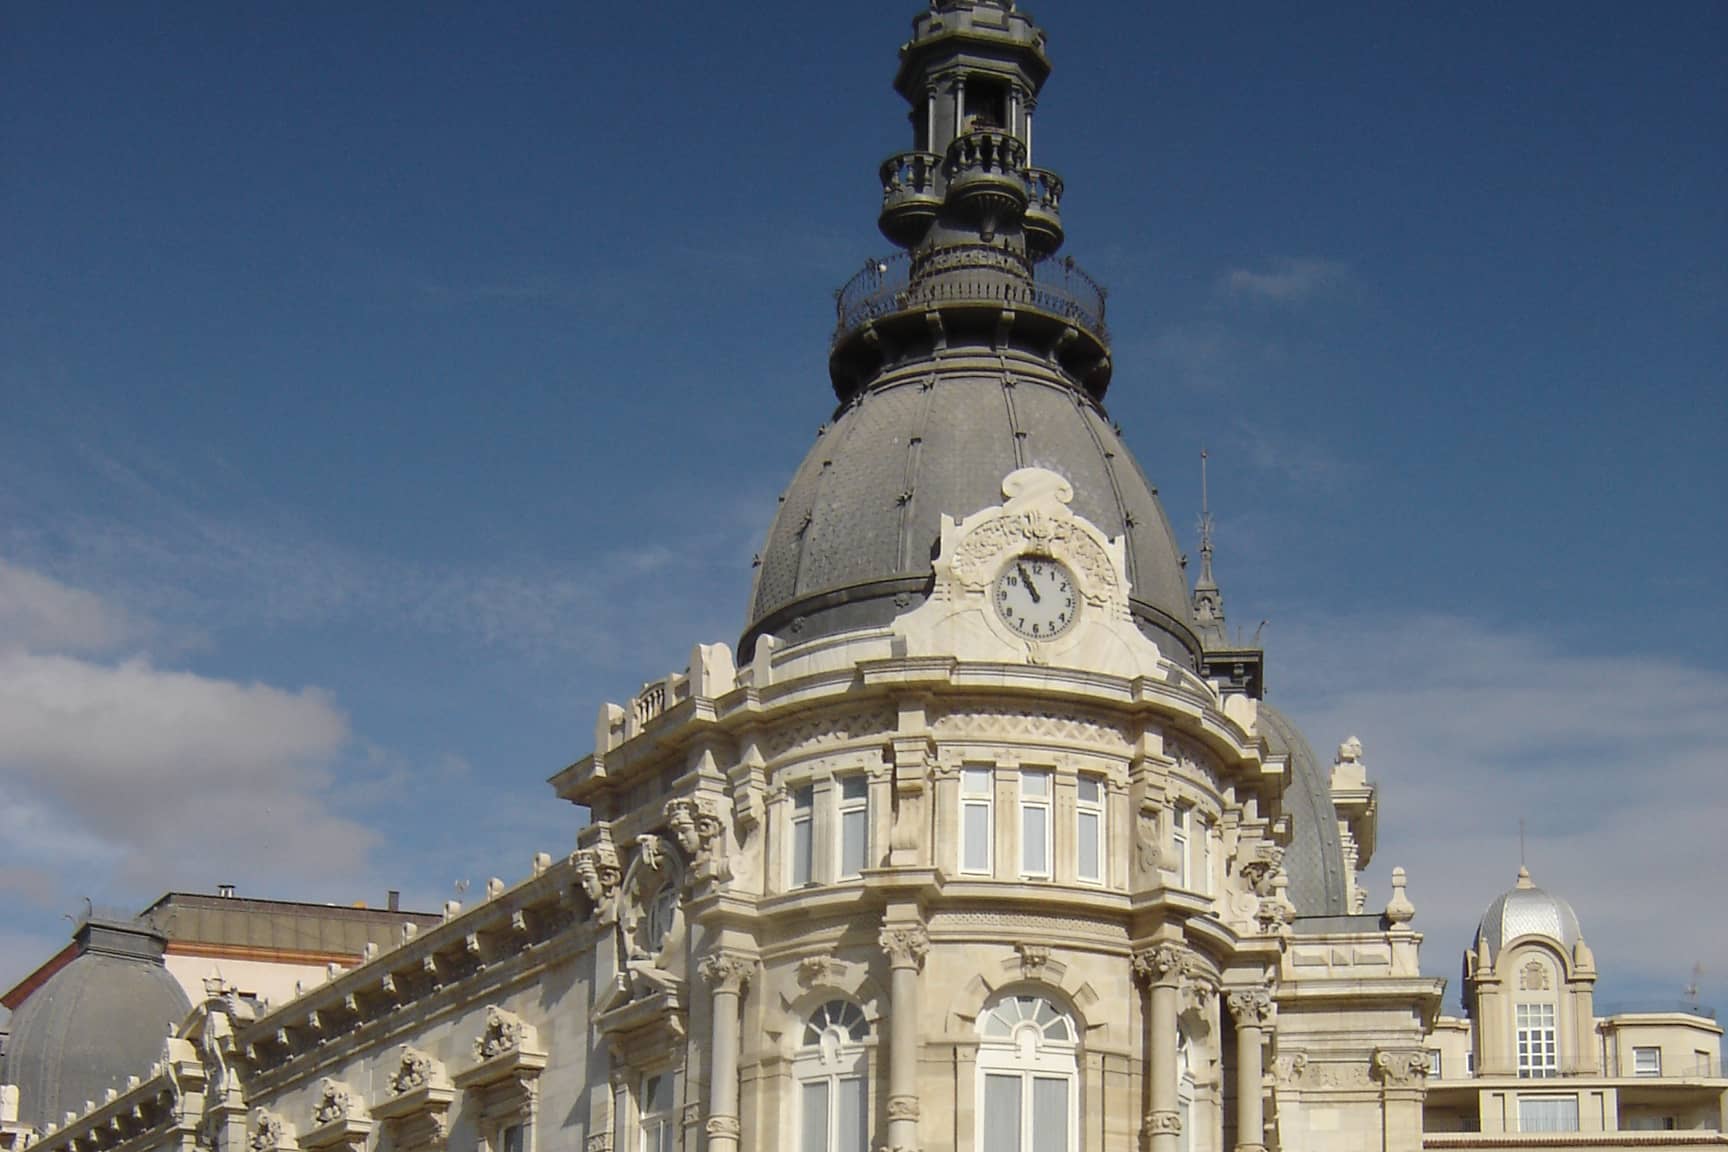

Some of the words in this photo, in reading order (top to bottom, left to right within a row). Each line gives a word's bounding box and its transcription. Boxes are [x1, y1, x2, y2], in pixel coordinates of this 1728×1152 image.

[1032, 565, 1042, 575] 12
[1007, 576, 1017, 586] 10
[1050, 571, 1055, 581] 1
[1060, 582, 1067, 592] 2
[1001, 590, 1008, 601] 9
[1065, 598, 1072, 608] 3
[1018, 617, 1025, 628] 7
[1058, 612, 1065, 623] 4
[1032, 623, 1039, 633] 6
[1048, 621, 1055, 631] 5
